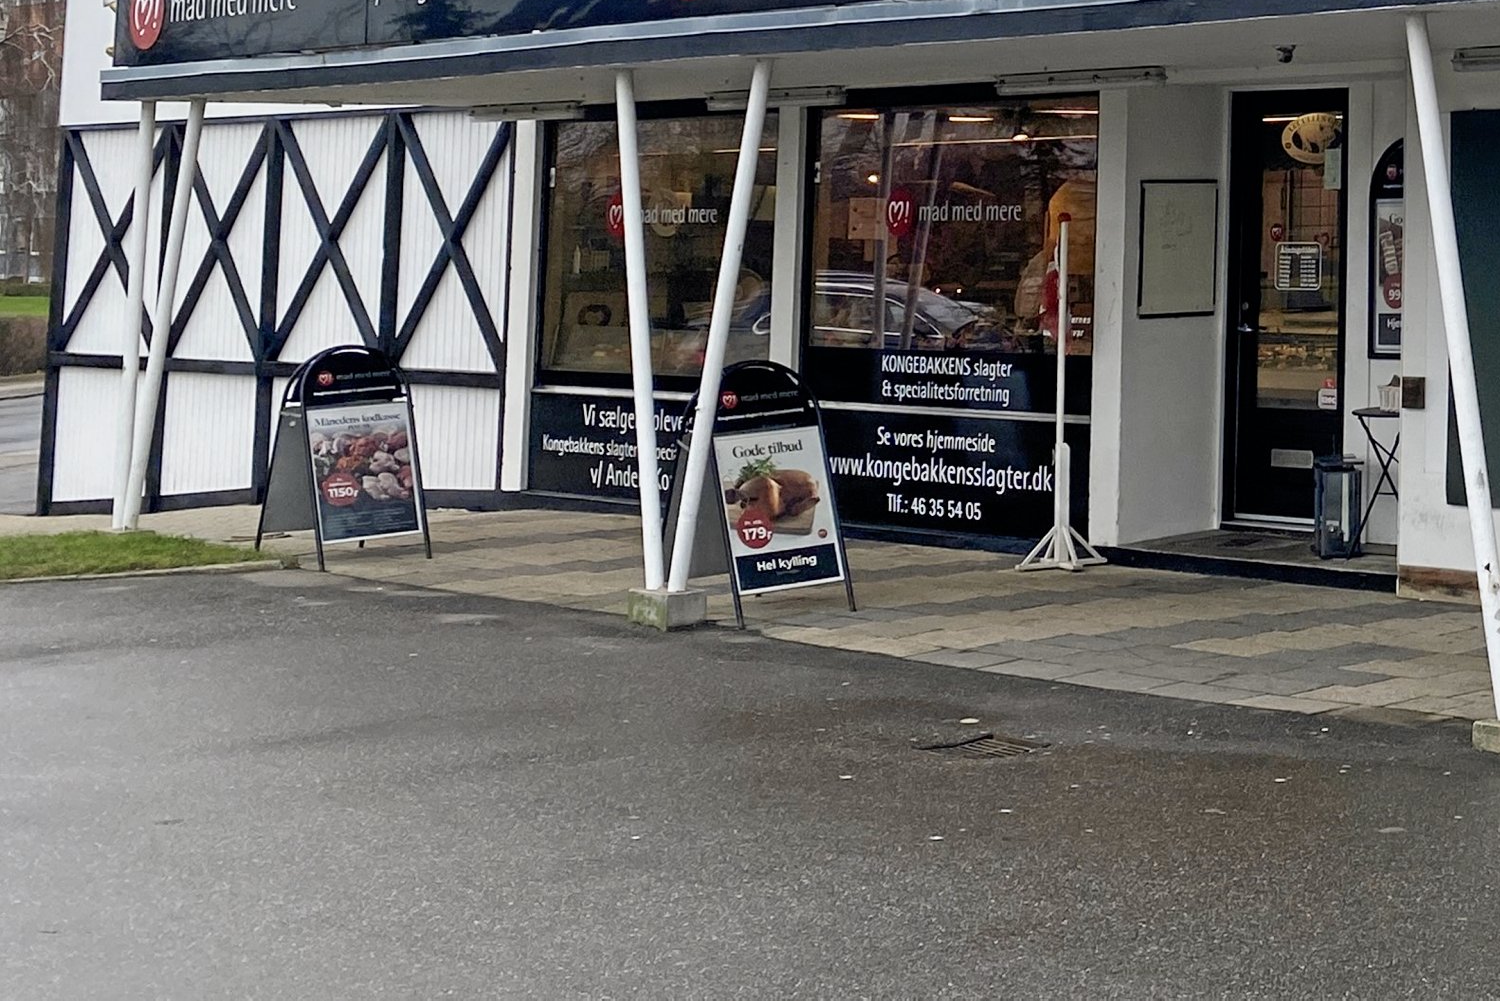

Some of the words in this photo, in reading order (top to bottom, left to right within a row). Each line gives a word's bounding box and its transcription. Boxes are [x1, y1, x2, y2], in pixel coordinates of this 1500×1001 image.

[660, 203, 686, 224] med
[687, 208, 718, 224] mere
[918, 199, 949, 222] mad
[952, 199, 983, 222] med
[985, 203, 1022, 222] mere
[881, 354, 971, 377] KONGEBAKKENS
[973, 358, 1013, 382] slagter
[881, 379, 892, 398] &
[893, 380, 1010, 408] specialitetsforretning
[582, 403, 596, 427] Vi
[542, 433, 605, 456] Kongebakkens
[606, 439, 638, 461] slagter
[732, 443, 766, 459] Gode
[768, 440, 804, 455] tilbud
[876, 426, 891, 446] Se
[893, 432, 924, 448] vores
[926, 429, 996, 454] hjemmeside
[590, 460, 604, 489] v/
[886, 493, 909, 514] Tlf.:
[910, 497, 926, 515] 46
[928, 498, 945, 517] 35
[947, 500, 963, 519] 54
[965, 502, 982, 521] 05
[756, 559, 777, 572] Hel
[778, 555, 817, 570] kylling
